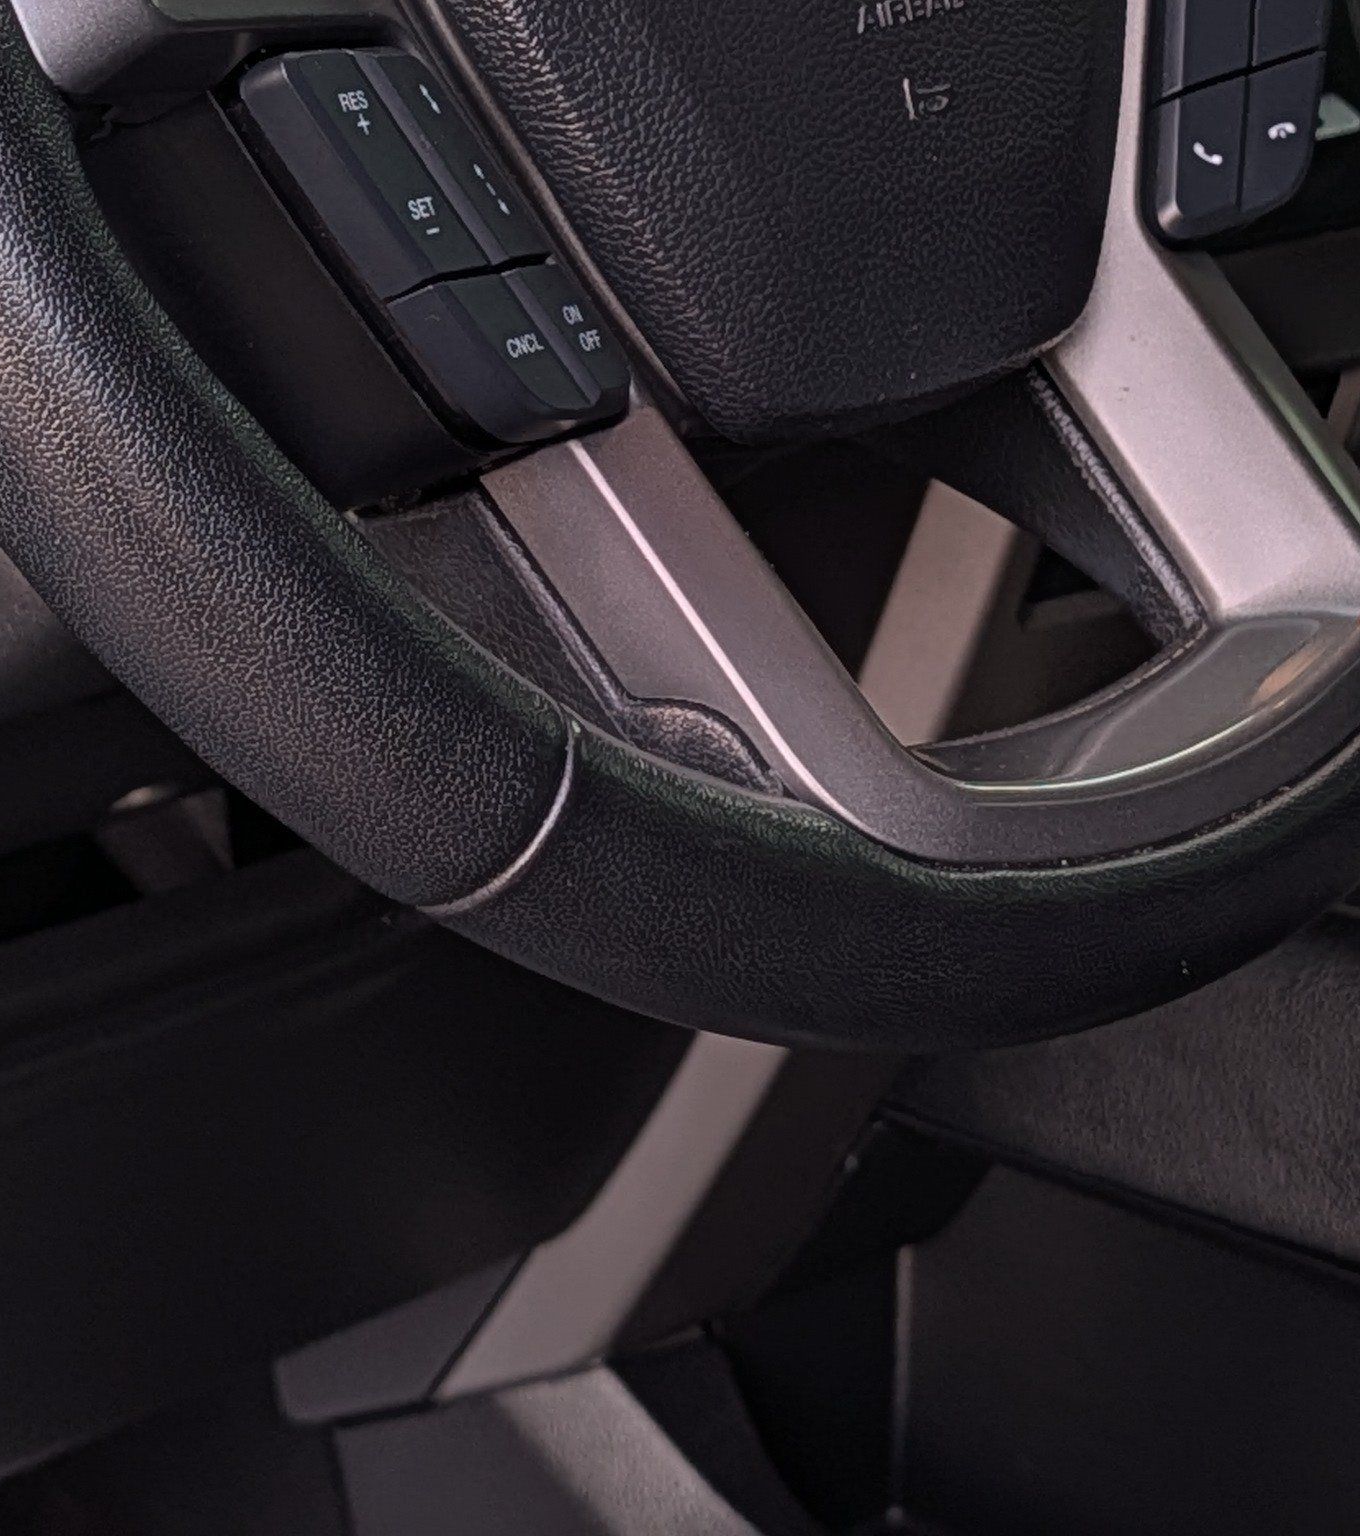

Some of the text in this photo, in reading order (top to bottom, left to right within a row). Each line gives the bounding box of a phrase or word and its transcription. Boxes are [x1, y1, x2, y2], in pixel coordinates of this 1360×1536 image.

[338, 90, 368, 112] RES
[407, 196, 435, 220] SET
[562, 304, 584, 325] ON
[505, 332, 545, 358] CNCL
[579, 329, 601, 352] OFF
